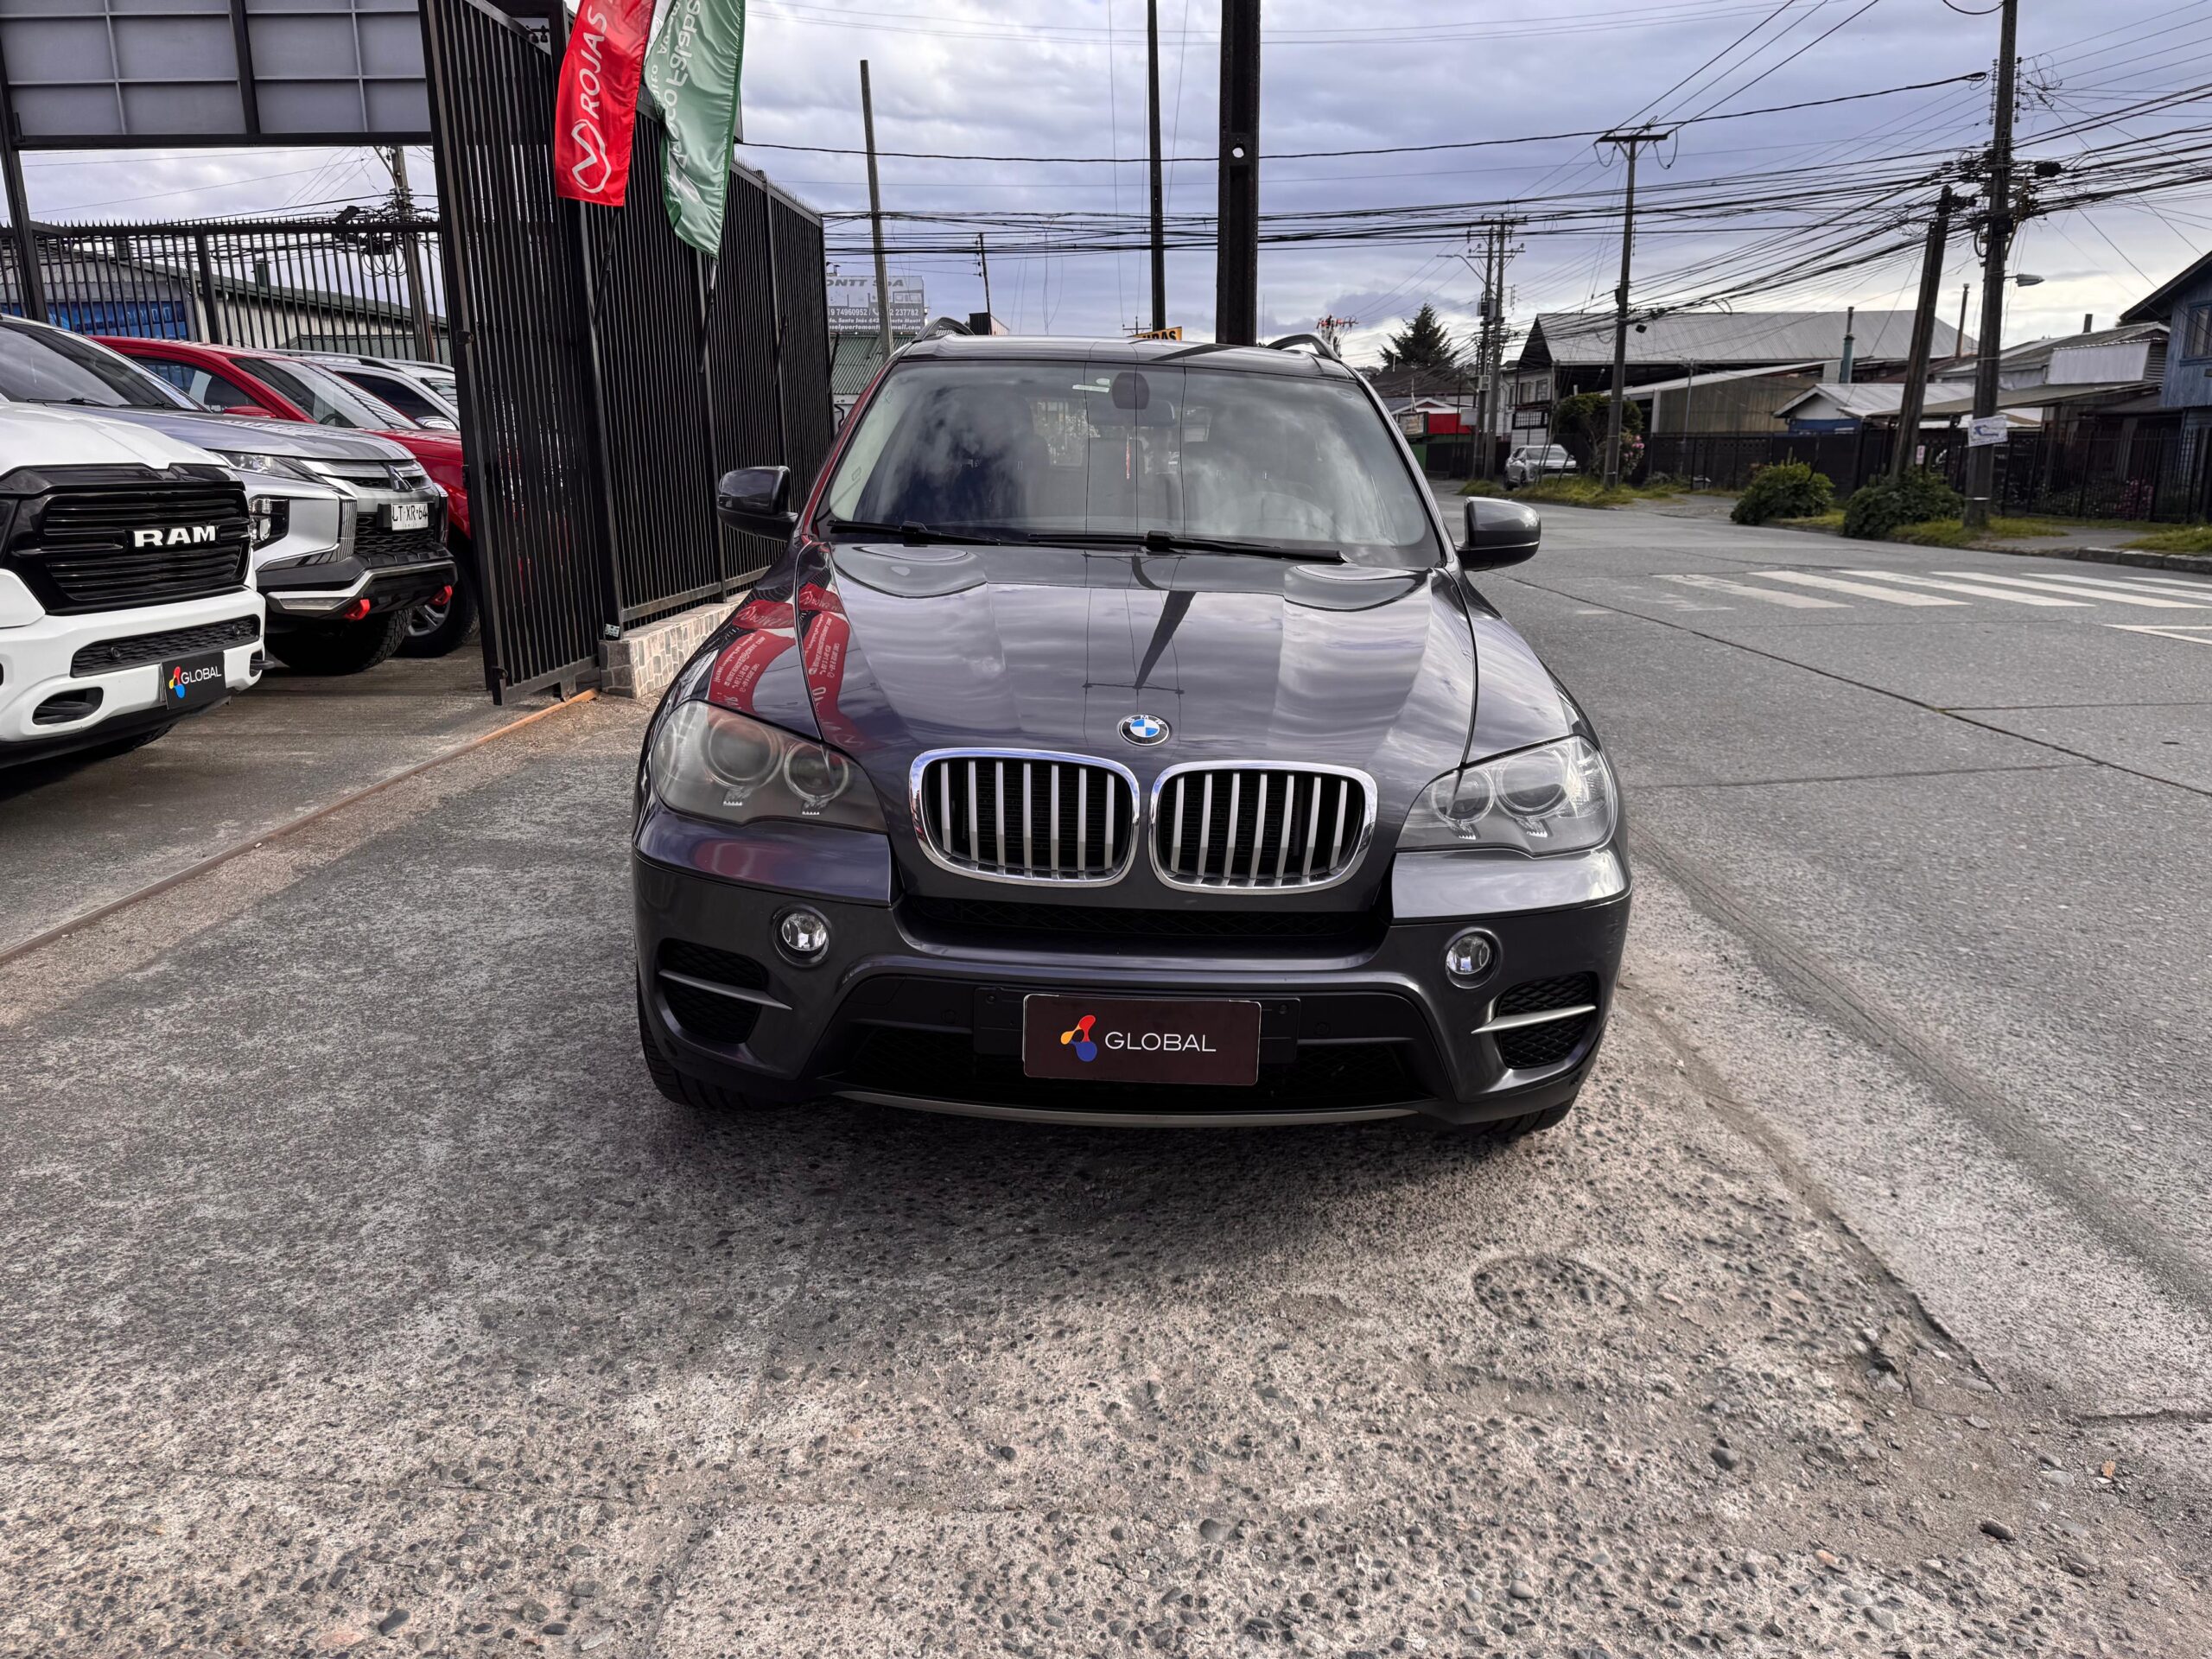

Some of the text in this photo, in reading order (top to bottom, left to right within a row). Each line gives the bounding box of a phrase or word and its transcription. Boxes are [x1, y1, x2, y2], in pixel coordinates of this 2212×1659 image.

[579, 5, 607, 119] ROJAS
[133, 525, 216, 548] RAM
[181, 665, 222, 684] GLOBAL
[1104, 1031, 1217, 1052] GLOBAL
